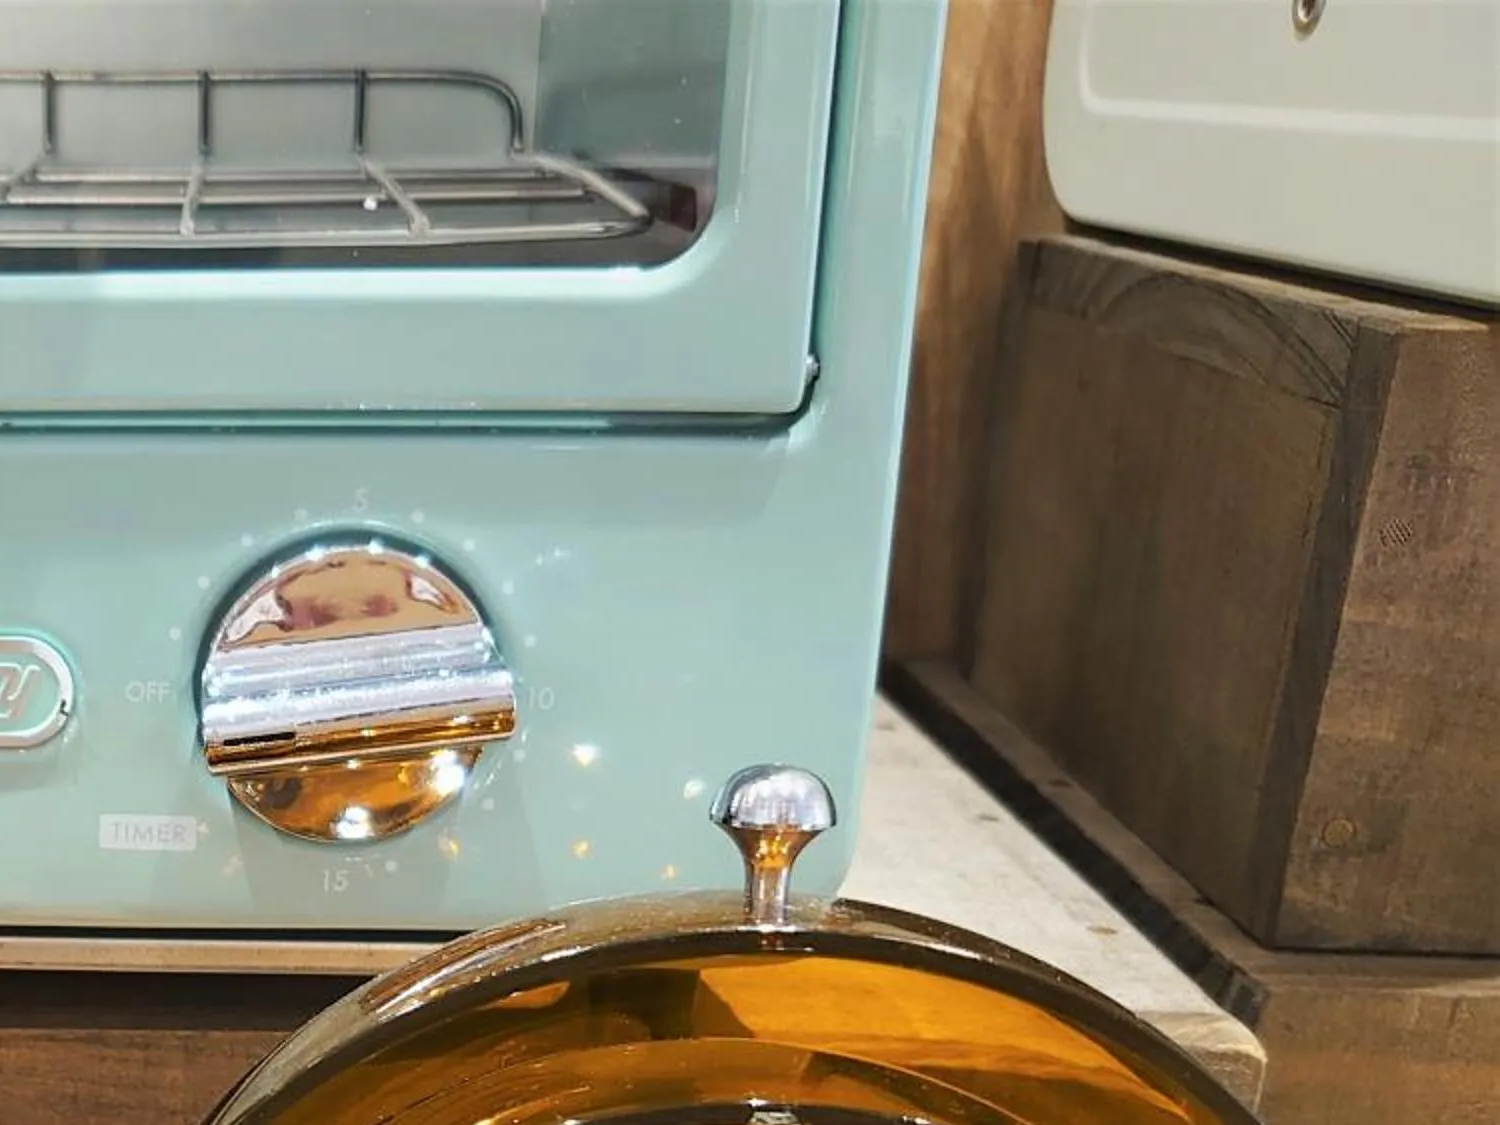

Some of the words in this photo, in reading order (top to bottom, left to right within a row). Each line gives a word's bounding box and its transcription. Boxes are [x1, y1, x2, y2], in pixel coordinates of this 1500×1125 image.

[125, 682, 171, 703] OFF
[112, 821, 187, 844] TIMER
[322, 870, 349, 891] 15
